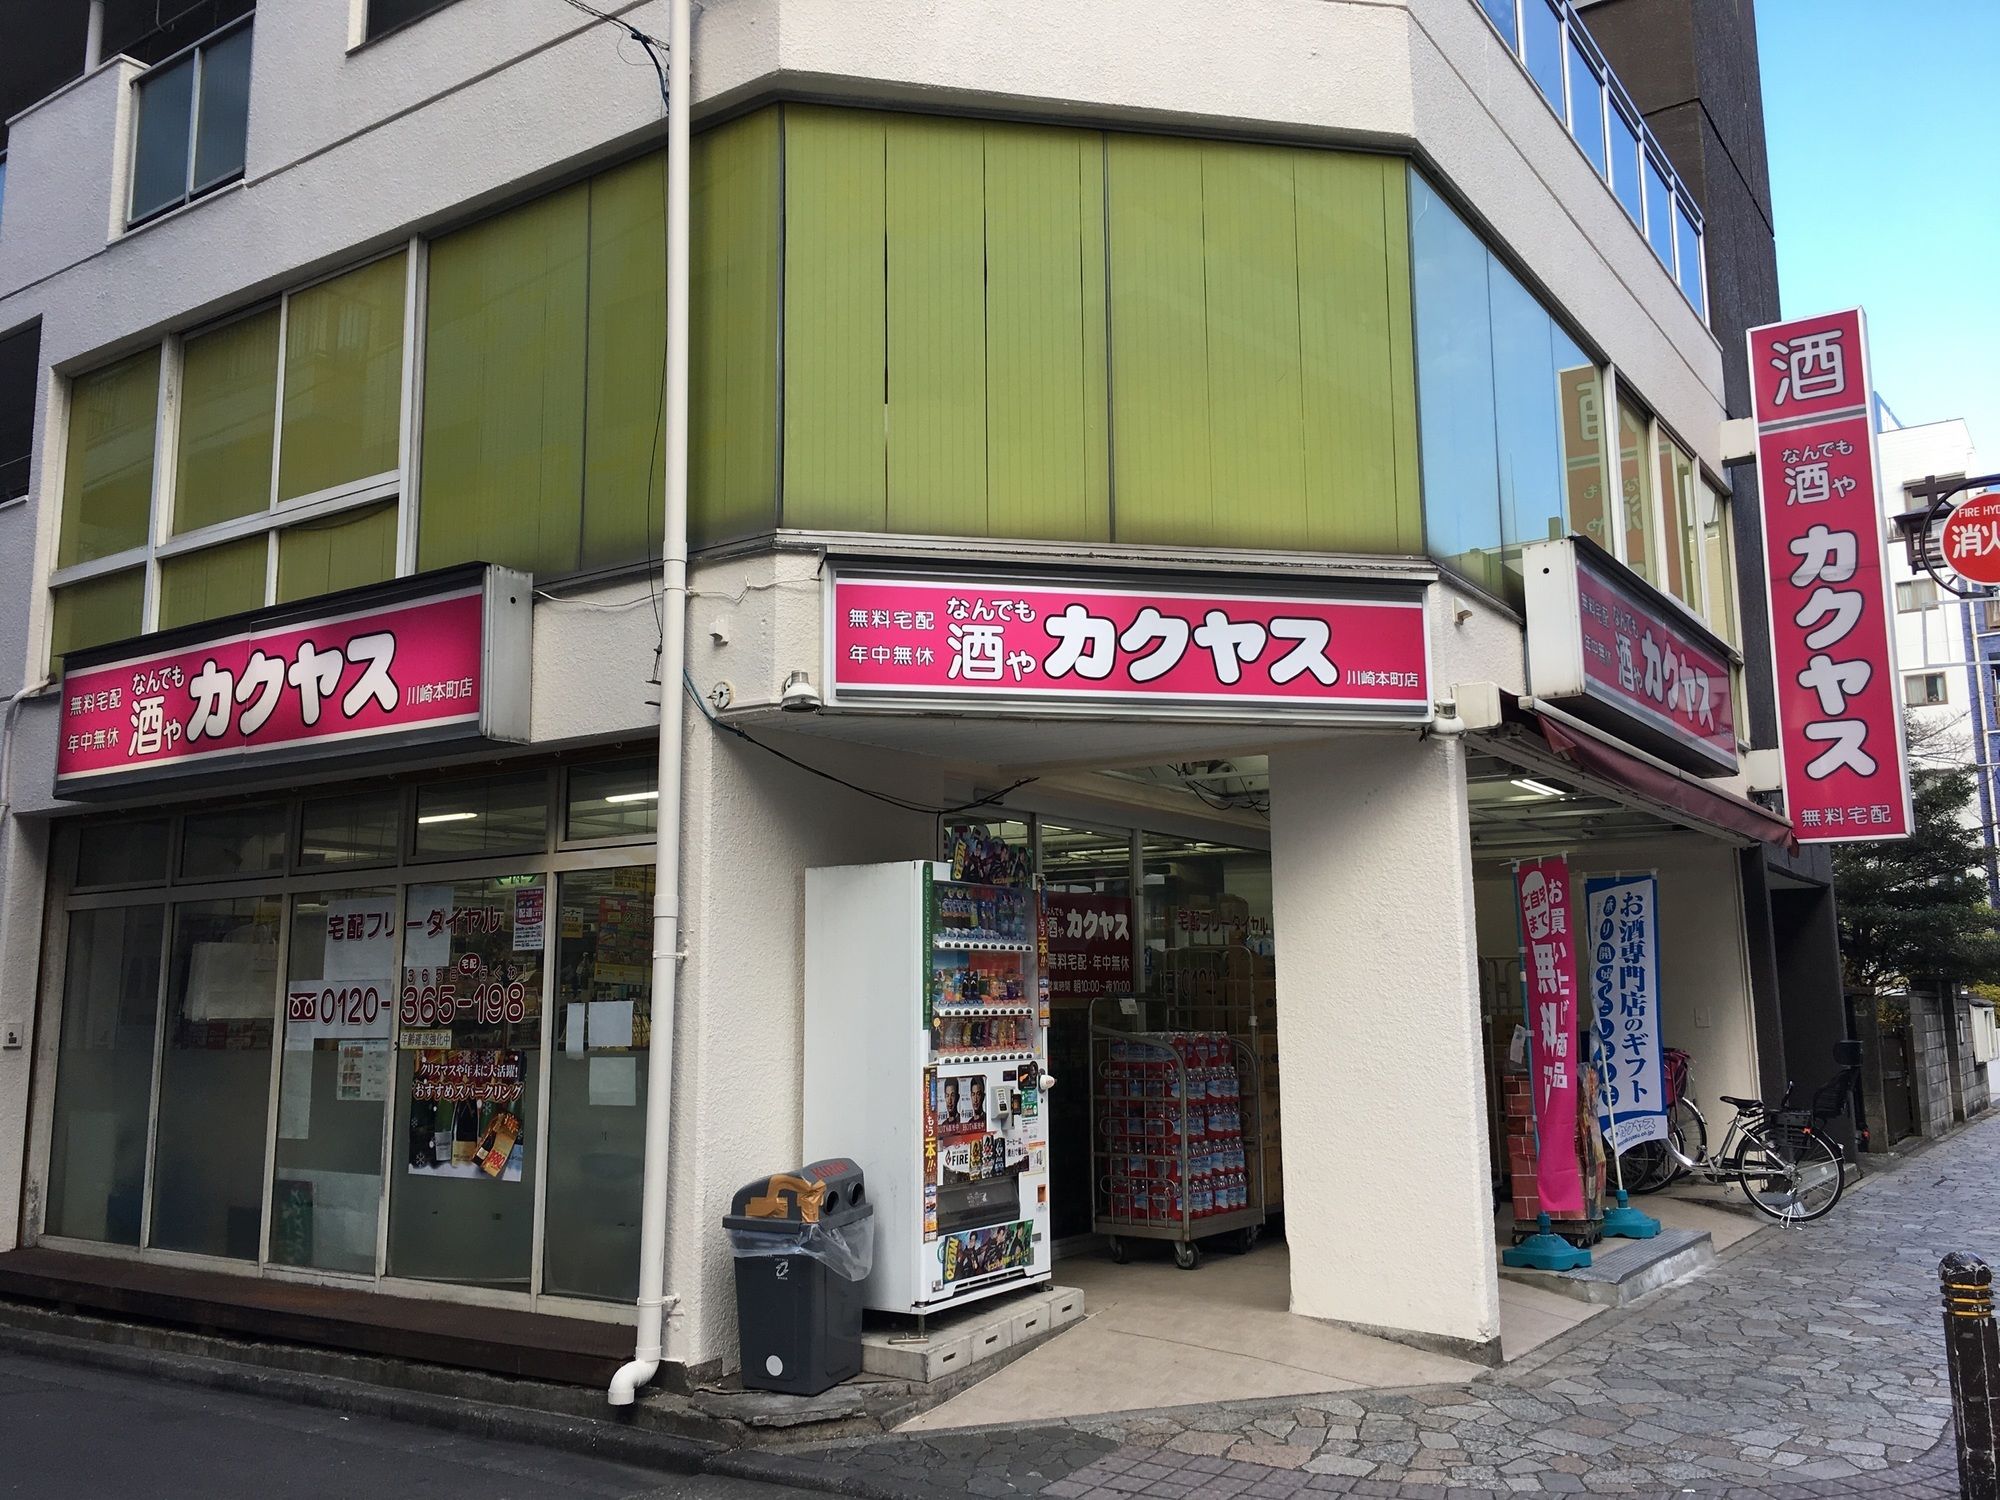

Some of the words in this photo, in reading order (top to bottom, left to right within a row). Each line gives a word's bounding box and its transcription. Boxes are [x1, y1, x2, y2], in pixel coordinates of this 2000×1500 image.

[1770, 328, 1846, 407] 酒
[1781, 438, 1854, 464] なんでも
[1783, 462, 1857, 507] 酒や
[1958, 506, 1980, 518] FIRE
[848, 608, 936, 631] 無料宅配
[946, 596, 1037, 623] なんでも
[848, 644, 935, 667] 年中無休
[946, 623, 1038, 683] 酒や
[1042, 603, 1340, 686] カクヤス
[1789, 523, 1878, 782] カクヤス
[131, 664, 185, 696] なんでも
[186, 630, 400, 744] カクヤス
[405, 676, 474, 707] 川崎本町店
[1345, 668, 1420, 689] 川崎本町店
[1640, 626, 1715, 733] カクヤス
[70, 687, 122, 716] 無料宅配
[67, 727, 120, 754] 年中無休
[127, 695, 182, 757] 酒や
[1801, 803, 1892, 828] 無料宅配
[1066, 907, 1130, 942] カクヤス
[320, 983, 525, 1025] 0120-365-198
[414, 1082, 524, 1100] おすすめスパークリング
[1617, 1118, 1656, 1137] カクヤス
[951, 1153, 969, 1166] FIRE
